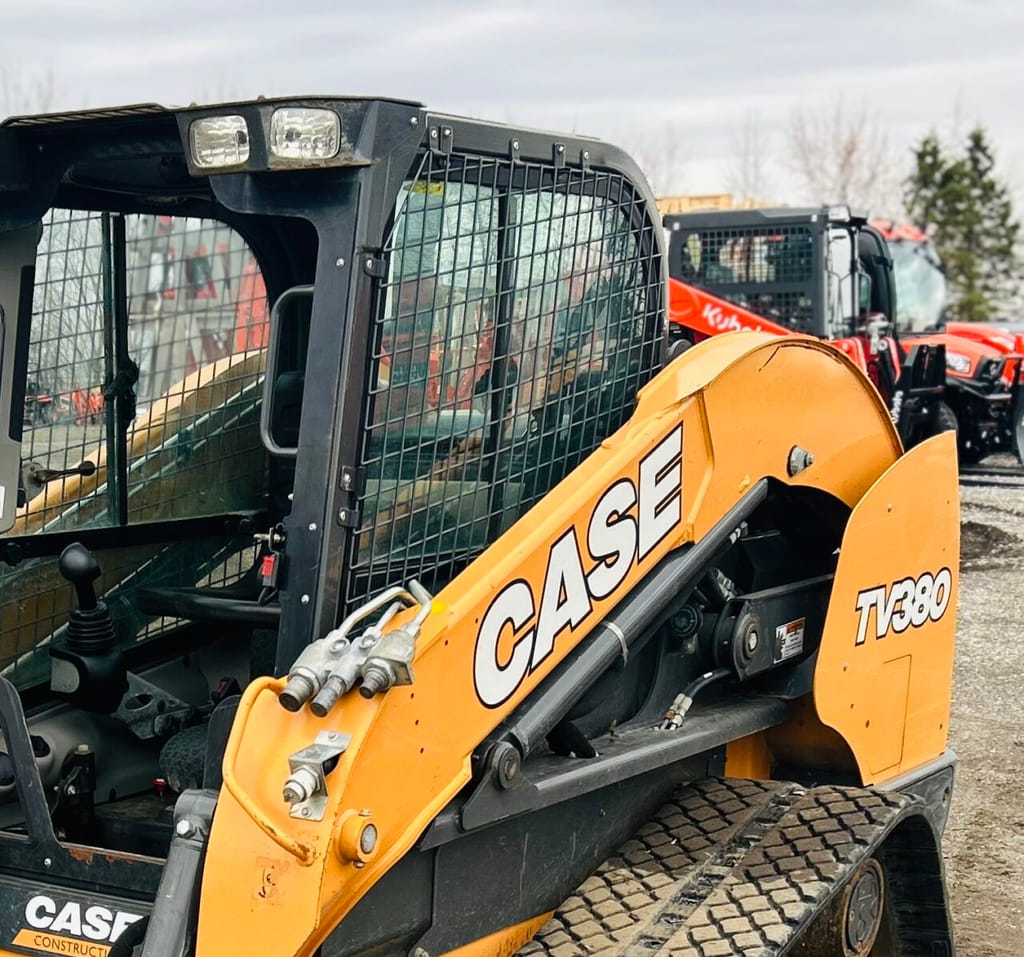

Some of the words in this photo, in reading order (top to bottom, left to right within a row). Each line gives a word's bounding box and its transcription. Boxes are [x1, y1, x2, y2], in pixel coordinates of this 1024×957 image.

[702, 303, 762, 332] Kub
[473, 420, 684, 709] CASE
[855, 567, 952, 646] TV380
